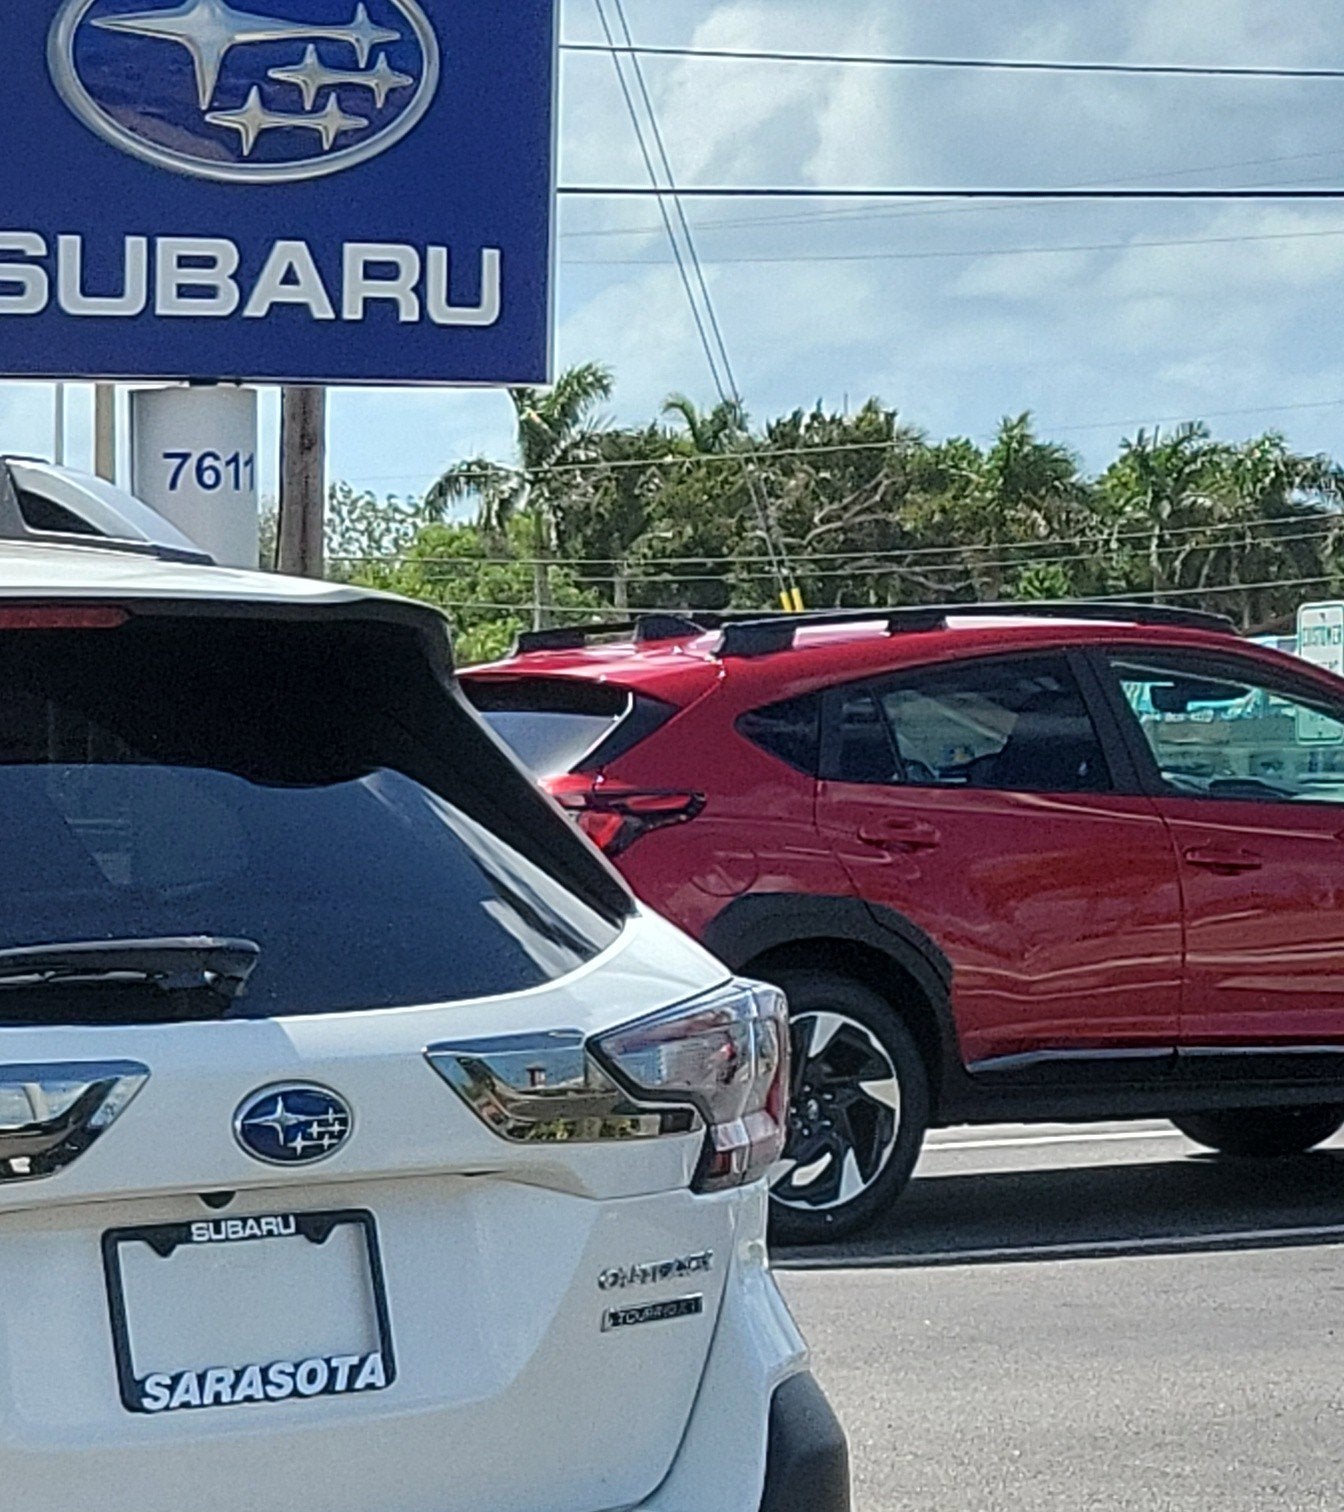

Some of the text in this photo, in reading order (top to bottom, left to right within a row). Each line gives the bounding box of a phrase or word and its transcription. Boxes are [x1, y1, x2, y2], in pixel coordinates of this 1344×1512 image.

[162, 450, 254, 492] 7611
[190, 1214, 297, 1242] SUBARU
[141, 1352, 386, 1411] SARASOTA
